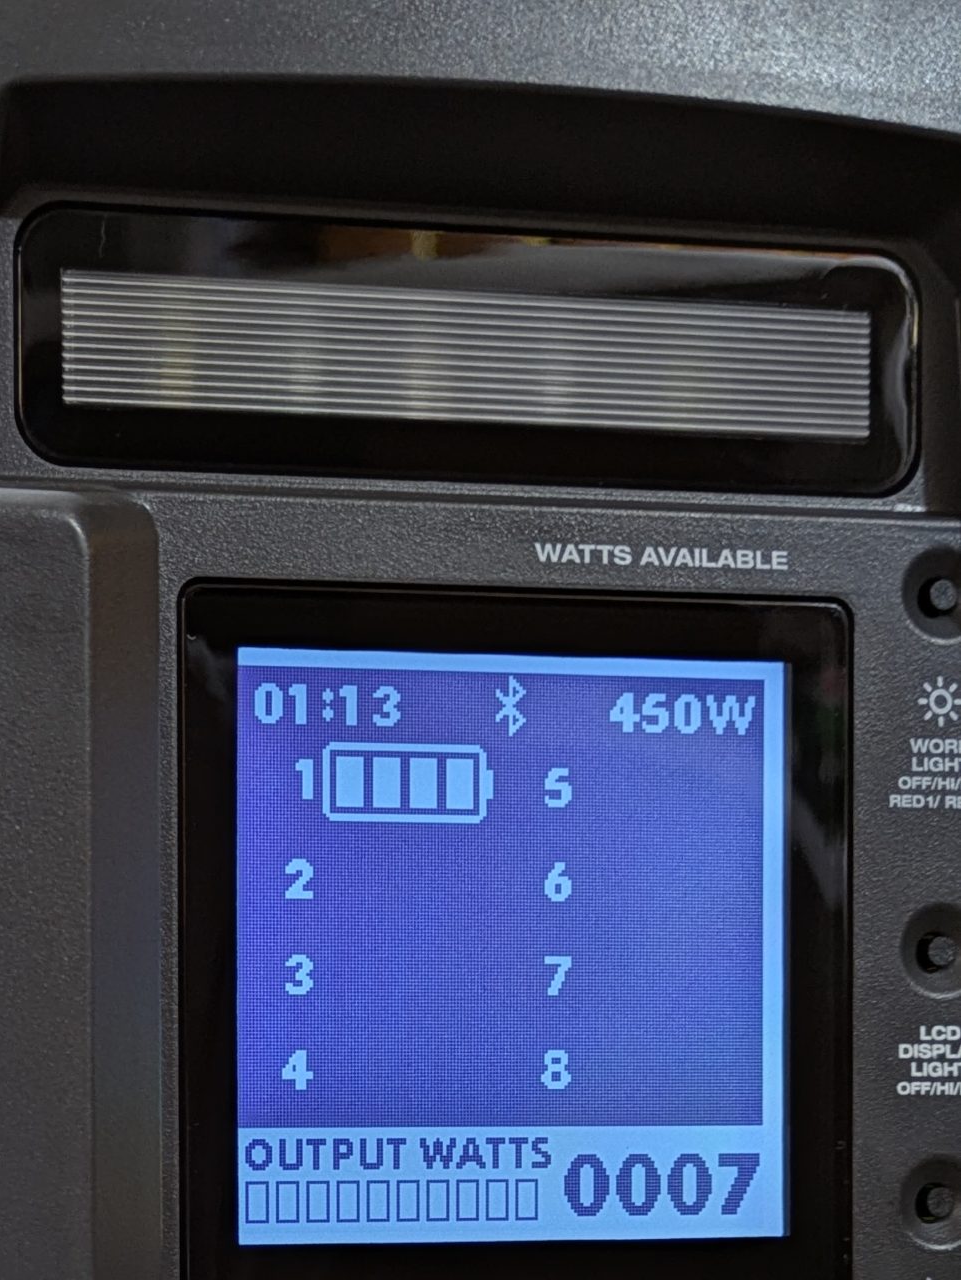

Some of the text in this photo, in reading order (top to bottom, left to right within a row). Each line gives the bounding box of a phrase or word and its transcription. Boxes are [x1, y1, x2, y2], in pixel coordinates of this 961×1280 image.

[535, 542, 789, 571] WATTS AVAILABLE
[254, 683, 402, 727] 01:13
[609, 692, 756, 735] 450W
[909, 737, 961, 754] WOR
[911, 756, 961, 772] LIGH
[295, 758, 315, 800] 1
[544, 768, 573, 808] 5
[284, 859, 314, 900] 2
[544, 862, 573, 902] 6
[285, 955, 314, 997] 3
[544, 956, 573, 997] 7
[898, 1043, 961, 1059] DISPL
[919, 1025, 961, 1041] LCD
[282, 1050, 314, 1091] 4
[541, 1050, 572, 1090] 8
[896, 1081, 961, 1096] OFF/HI/
[245, 1136, 551, 1171] OUTPUT WATTS
[563, 1153, 761, 1217] 0007
